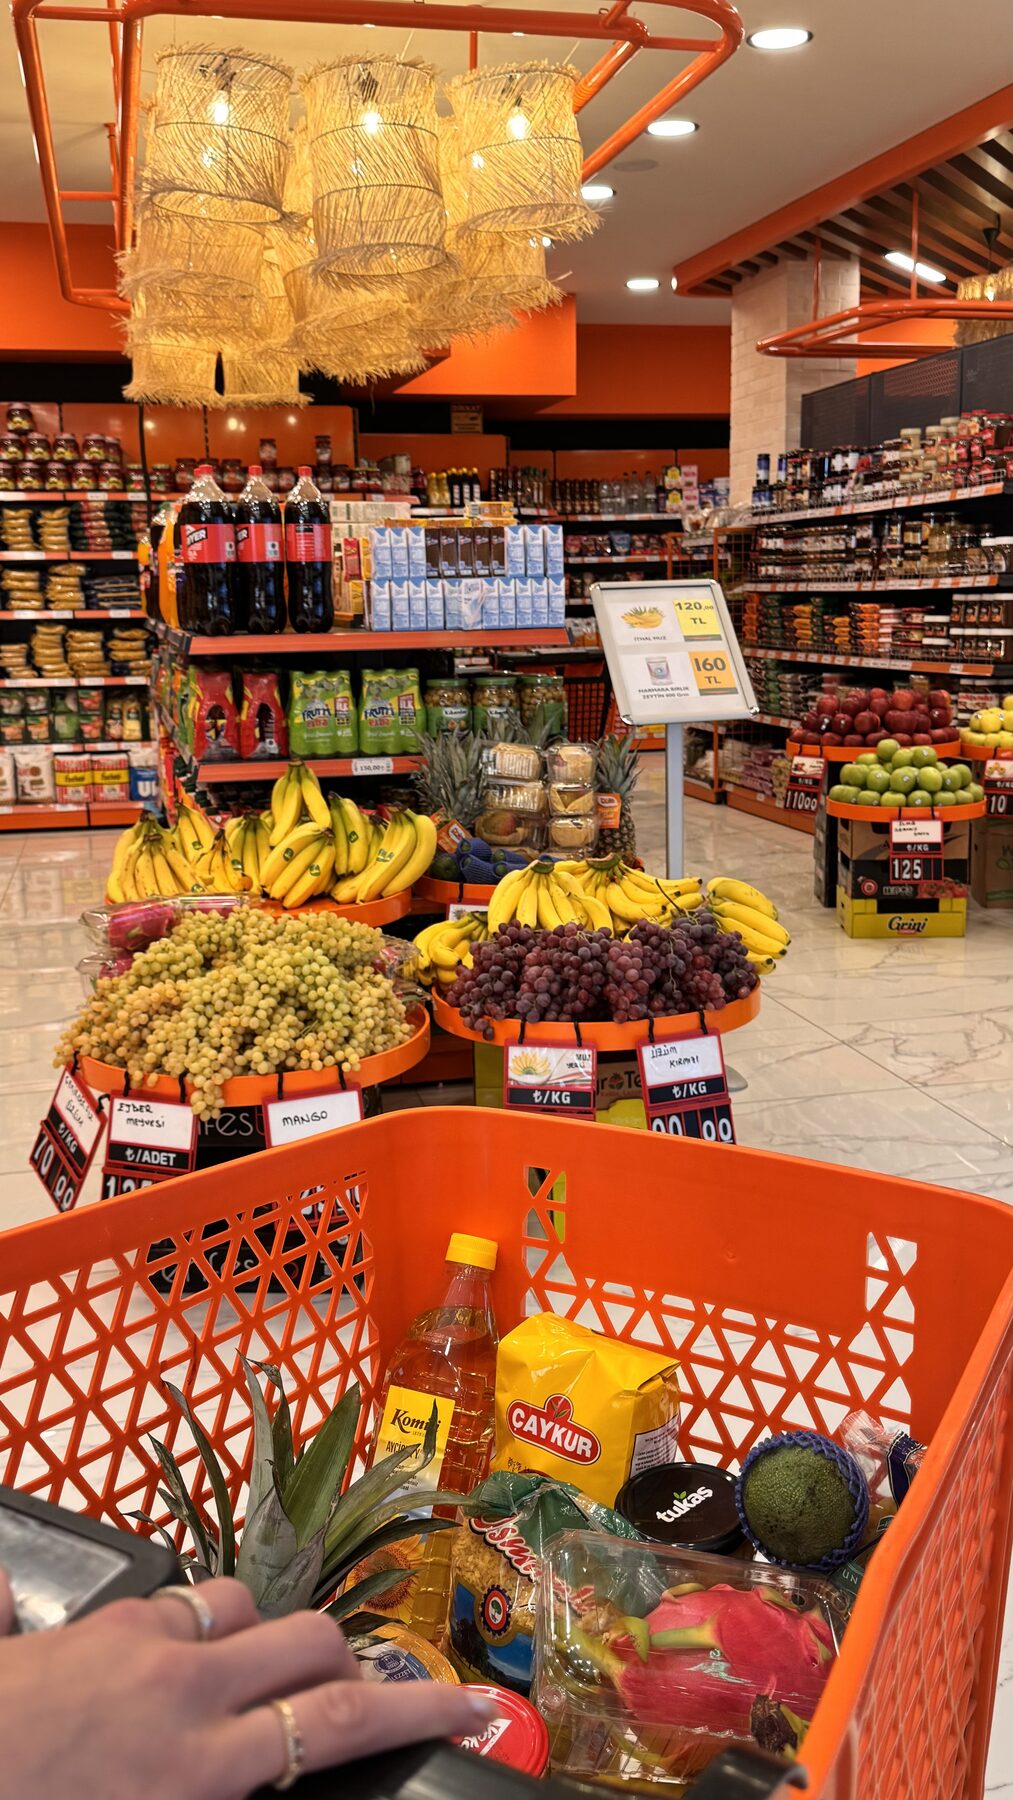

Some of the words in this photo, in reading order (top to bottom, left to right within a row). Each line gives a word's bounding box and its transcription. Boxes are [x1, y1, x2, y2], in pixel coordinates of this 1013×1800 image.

[690, 617, 707, 625] TL
[694, 657, 726, 672] 160
[704, 675, 722, 684] TL
[893, 858, 922, 879] 125
[282, 1110, 328, 1127] MANGO
[512, 1407, 593, 1458] ÇAYKUR
